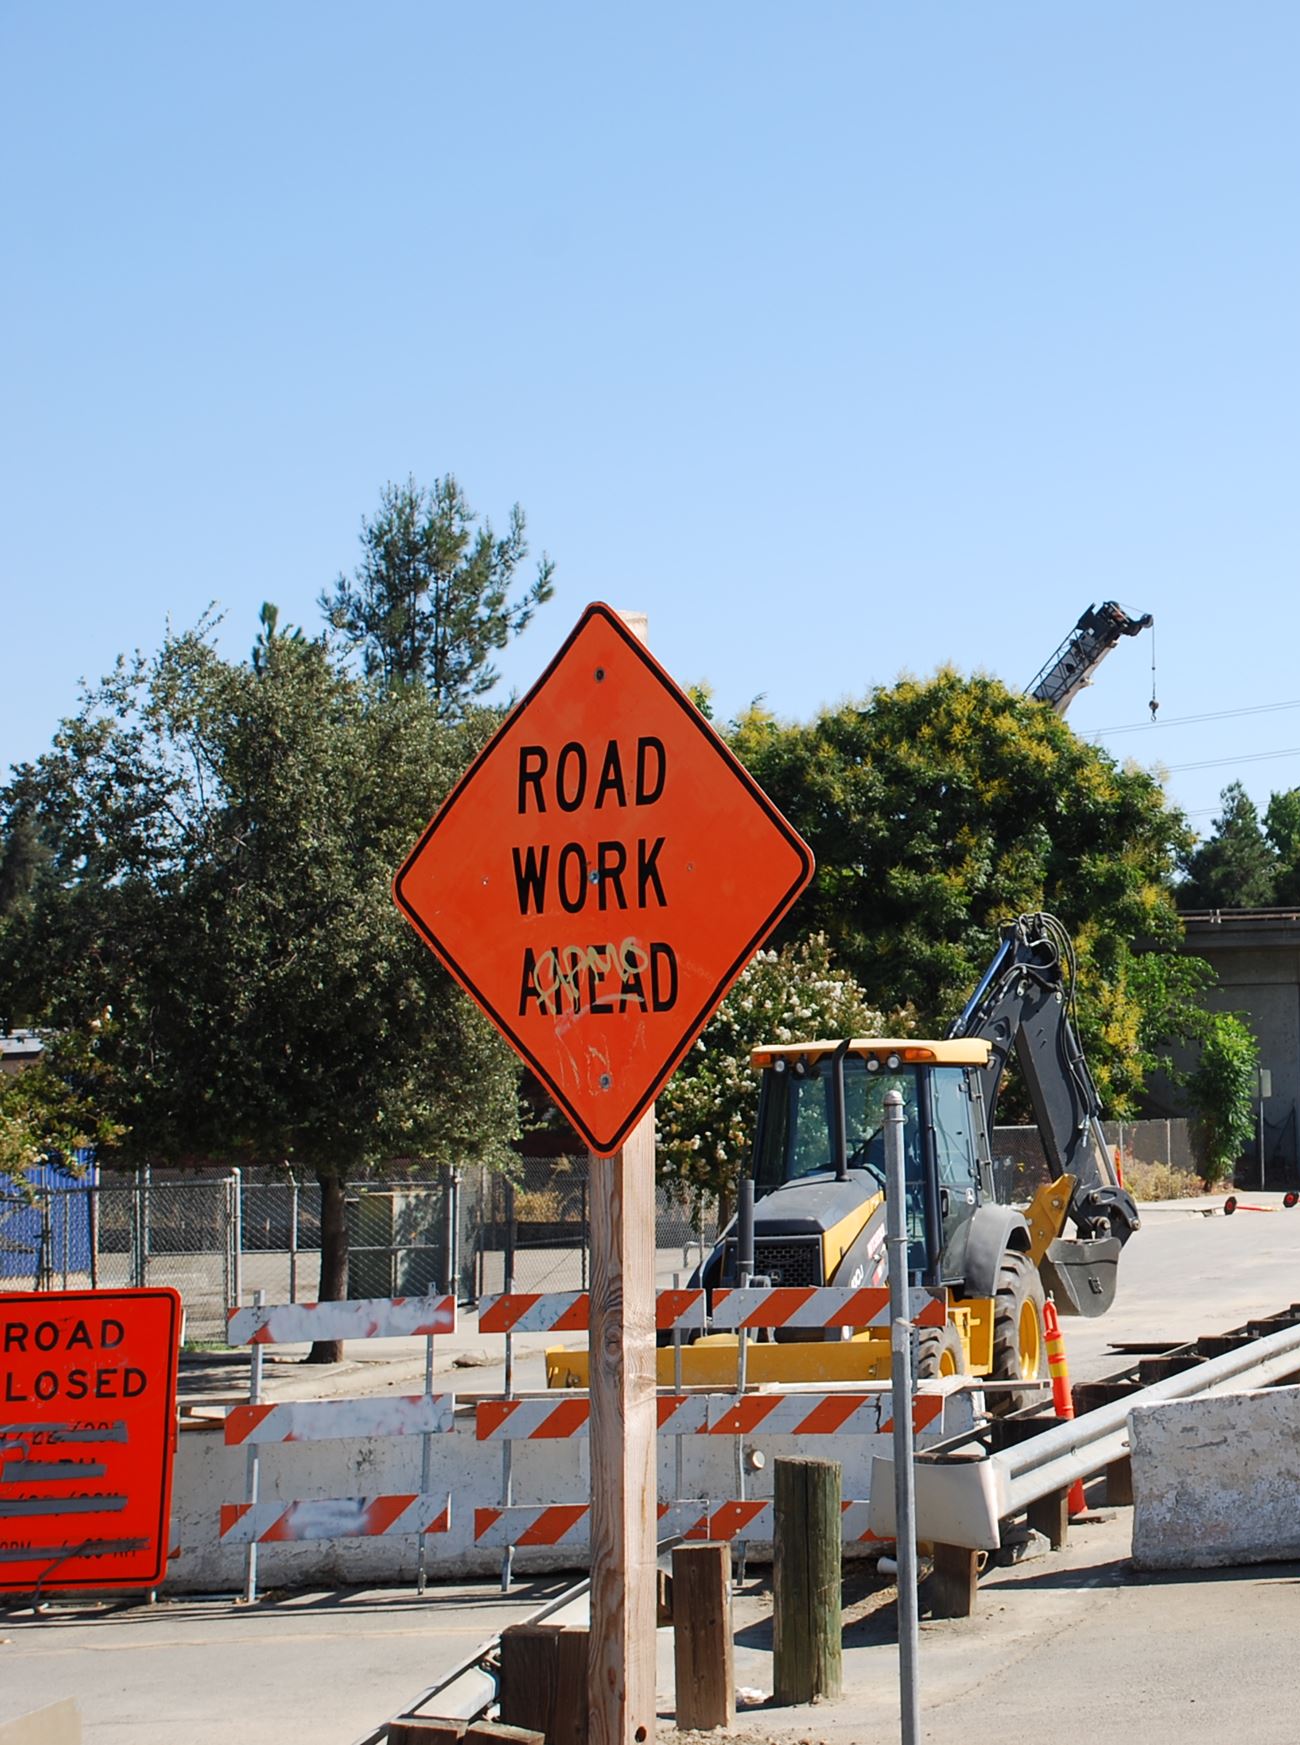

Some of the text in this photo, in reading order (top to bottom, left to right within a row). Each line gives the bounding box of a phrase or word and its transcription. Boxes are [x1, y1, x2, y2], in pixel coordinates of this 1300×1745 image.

[517, 736, 667, 814] ROAD
[511, 837, 667, 915] WORK
[518, 942, 679, 1016] AHEAD
[4, 1319, 125, 1352] ROAD
[5, 1367, 147, 1402] LOSED
